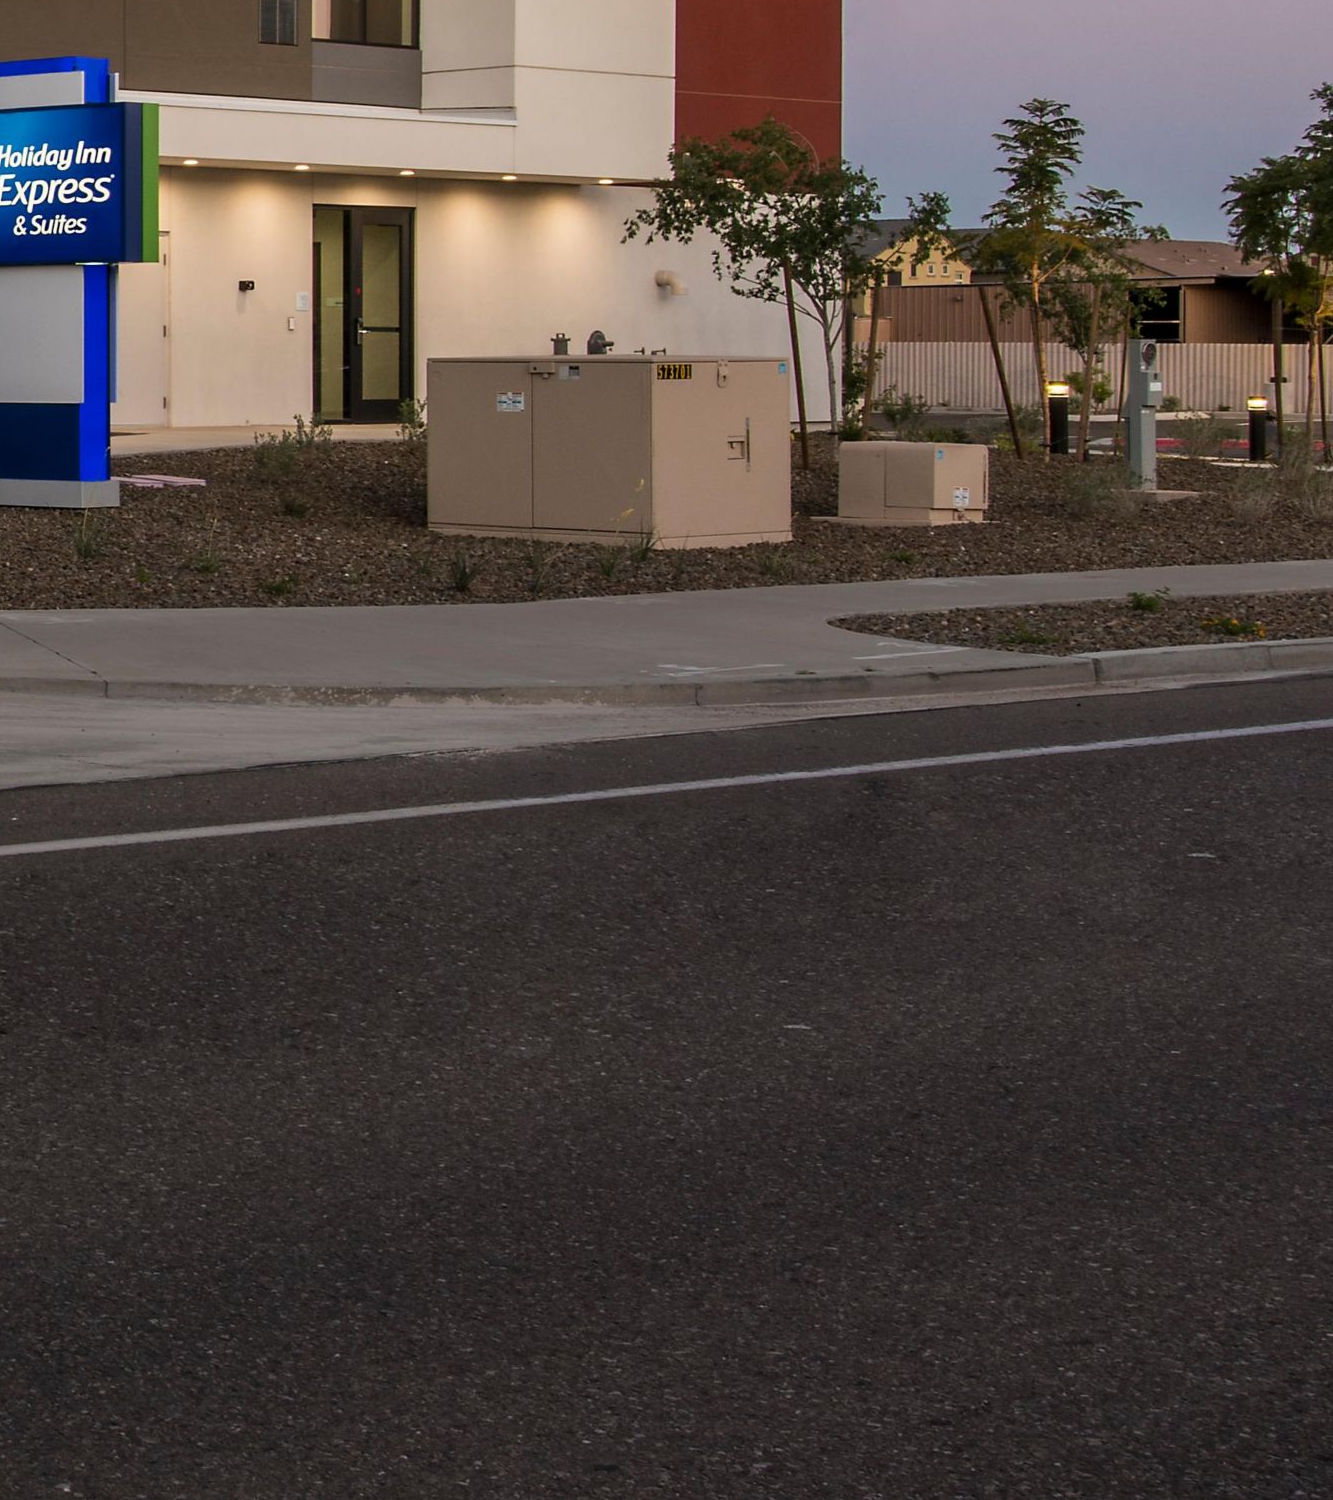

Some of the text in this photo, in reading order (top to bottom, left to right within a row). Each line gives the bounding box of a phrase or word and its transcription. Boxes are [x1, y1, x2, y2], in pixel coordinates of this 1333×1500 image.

[75, 140, 111, 165] Inn
[13, 214, 87, 236] & Suites
[657, 364, 692, 380] 573701
